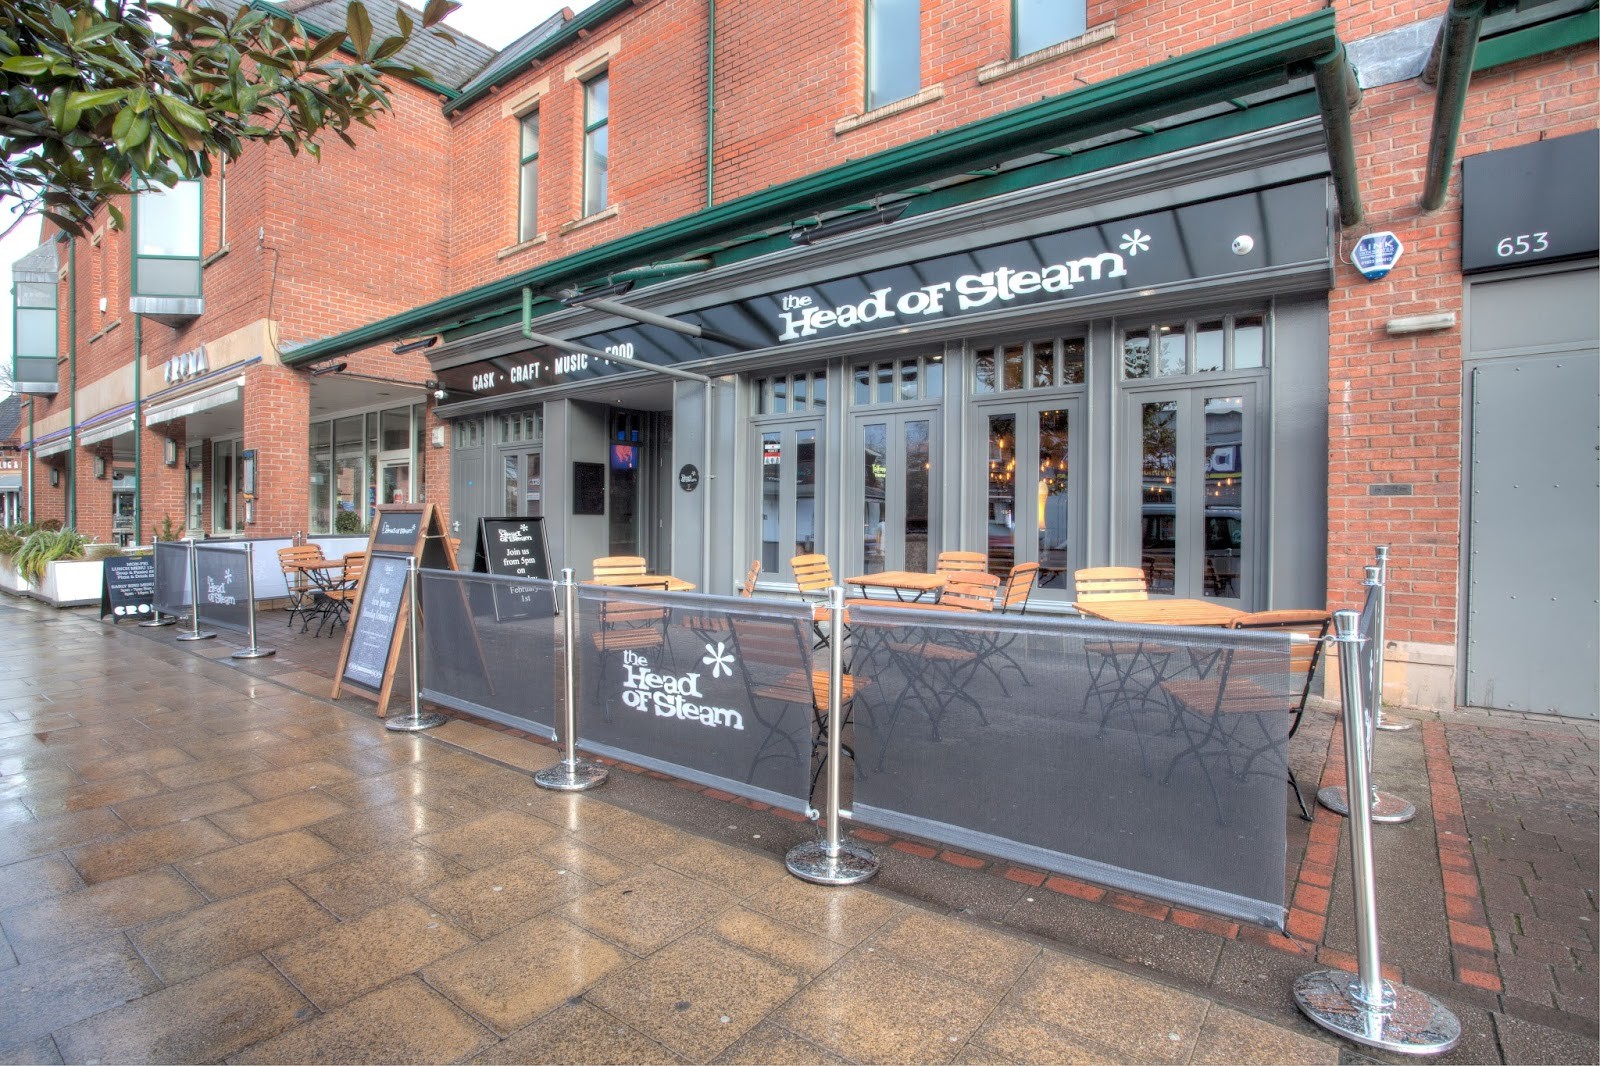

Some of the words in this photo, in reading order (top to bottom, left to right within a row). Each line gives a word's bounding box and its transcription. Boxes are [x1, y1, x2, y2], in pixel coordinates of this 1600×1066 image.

[1359, 241, 1393, 252] LINK
[1497, 231, 1550, 257] 653
[778, 287, 896, 342] Head
[955, 251, 1128, 311] Steam
[781, 294, 813, 312] the
[472, 372, 495, 392] CASK
[510, 362, 541, 384] CRAFT
[554, 353, 589, 376] MUSIC
[503, 558, 520, 566] from
[521, 556, 536, 565] 5pm
[506, 548, 521, 556] Join
[509, 586, 539, 594] February
[622, 649, 649, 666] the
[622, 664, 703, 698] Head
[652, 690, 745, 731] Steam
